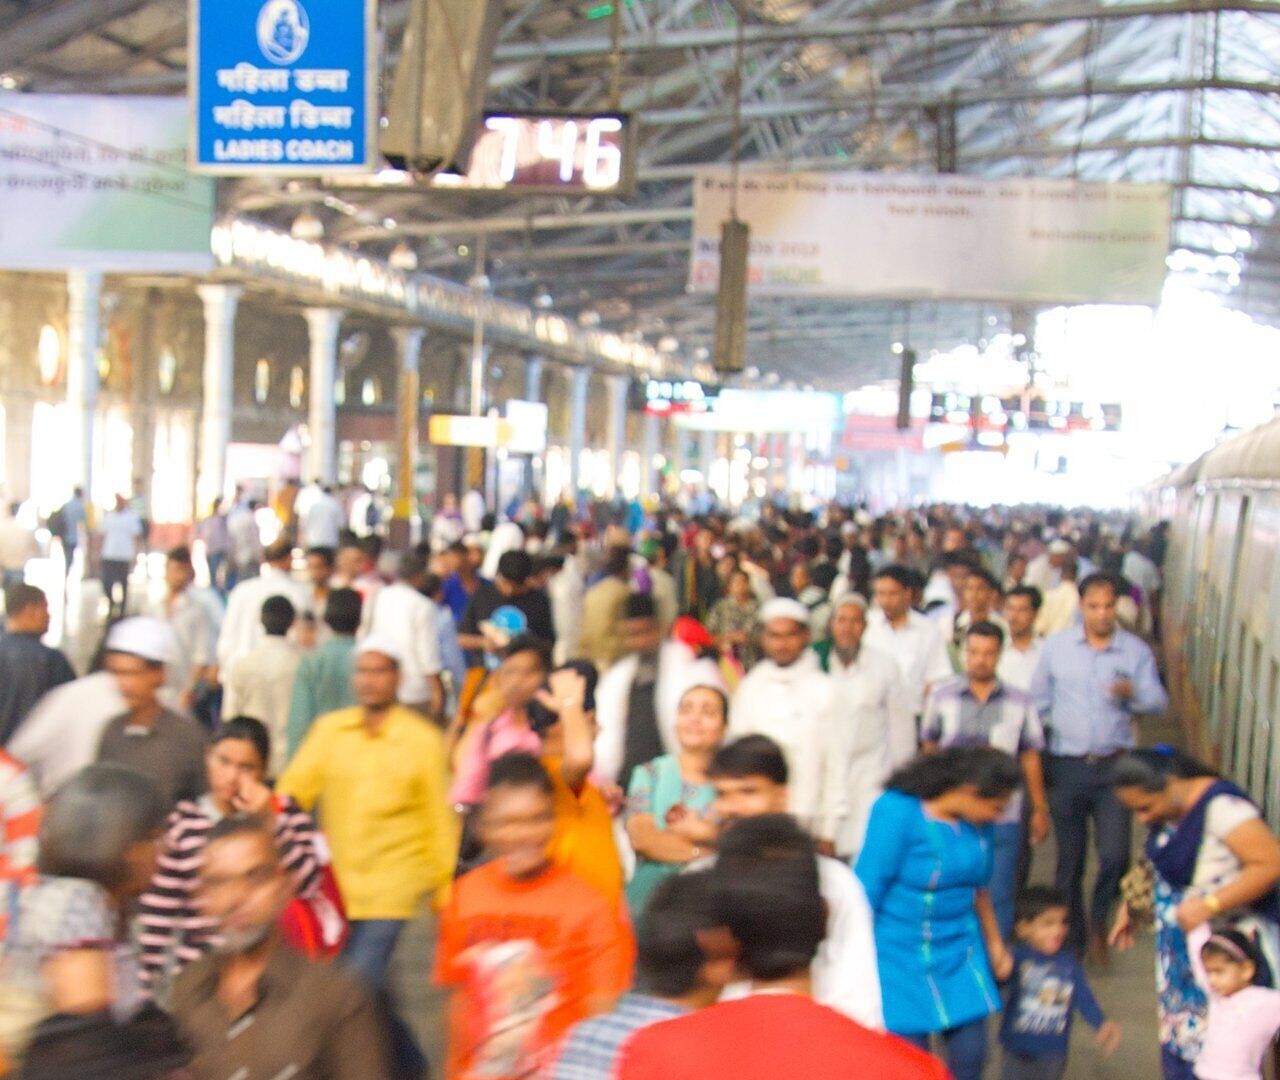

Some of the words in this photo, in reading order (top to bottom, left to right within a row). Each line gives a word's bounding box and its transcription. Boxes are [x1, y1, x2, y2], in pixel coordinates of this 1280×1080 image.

[216, 62, 290, 94] महिला
[212, 99, 286, 131] महिला
[214, 139, 283, 161] LADIES
[285, 139, 354, 161] COACH
